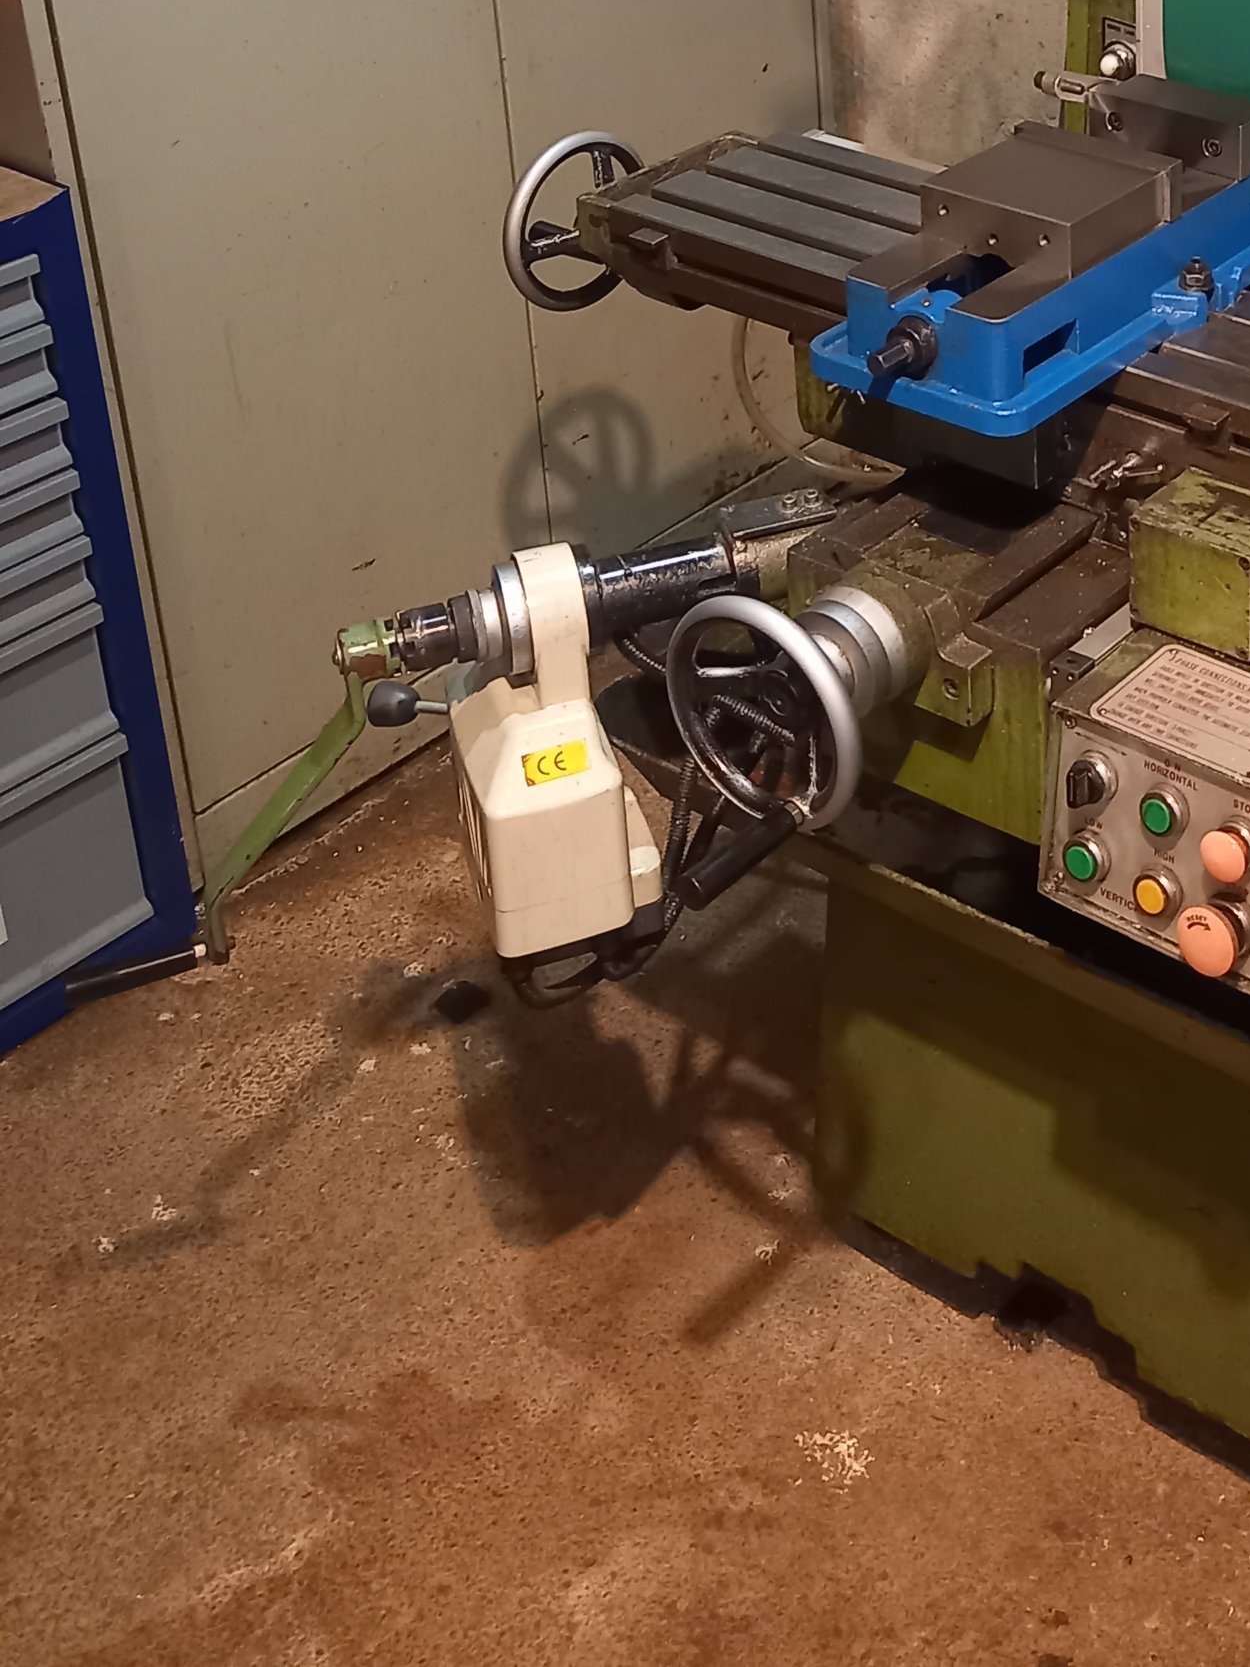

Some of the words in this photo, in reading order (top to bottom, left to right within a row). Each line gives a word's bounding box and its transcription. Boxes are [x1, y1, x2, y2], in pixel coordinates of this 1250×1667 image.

[1196, 666, 1249, 691] CONNECTIONS
[1144, 760, 1199, 791] HORIZONTAL
[1084, 816, 1103, 830] LOW
[1153, 847, 1175, 865] HIGH
[1186, 914, 1208, 923] RESET
